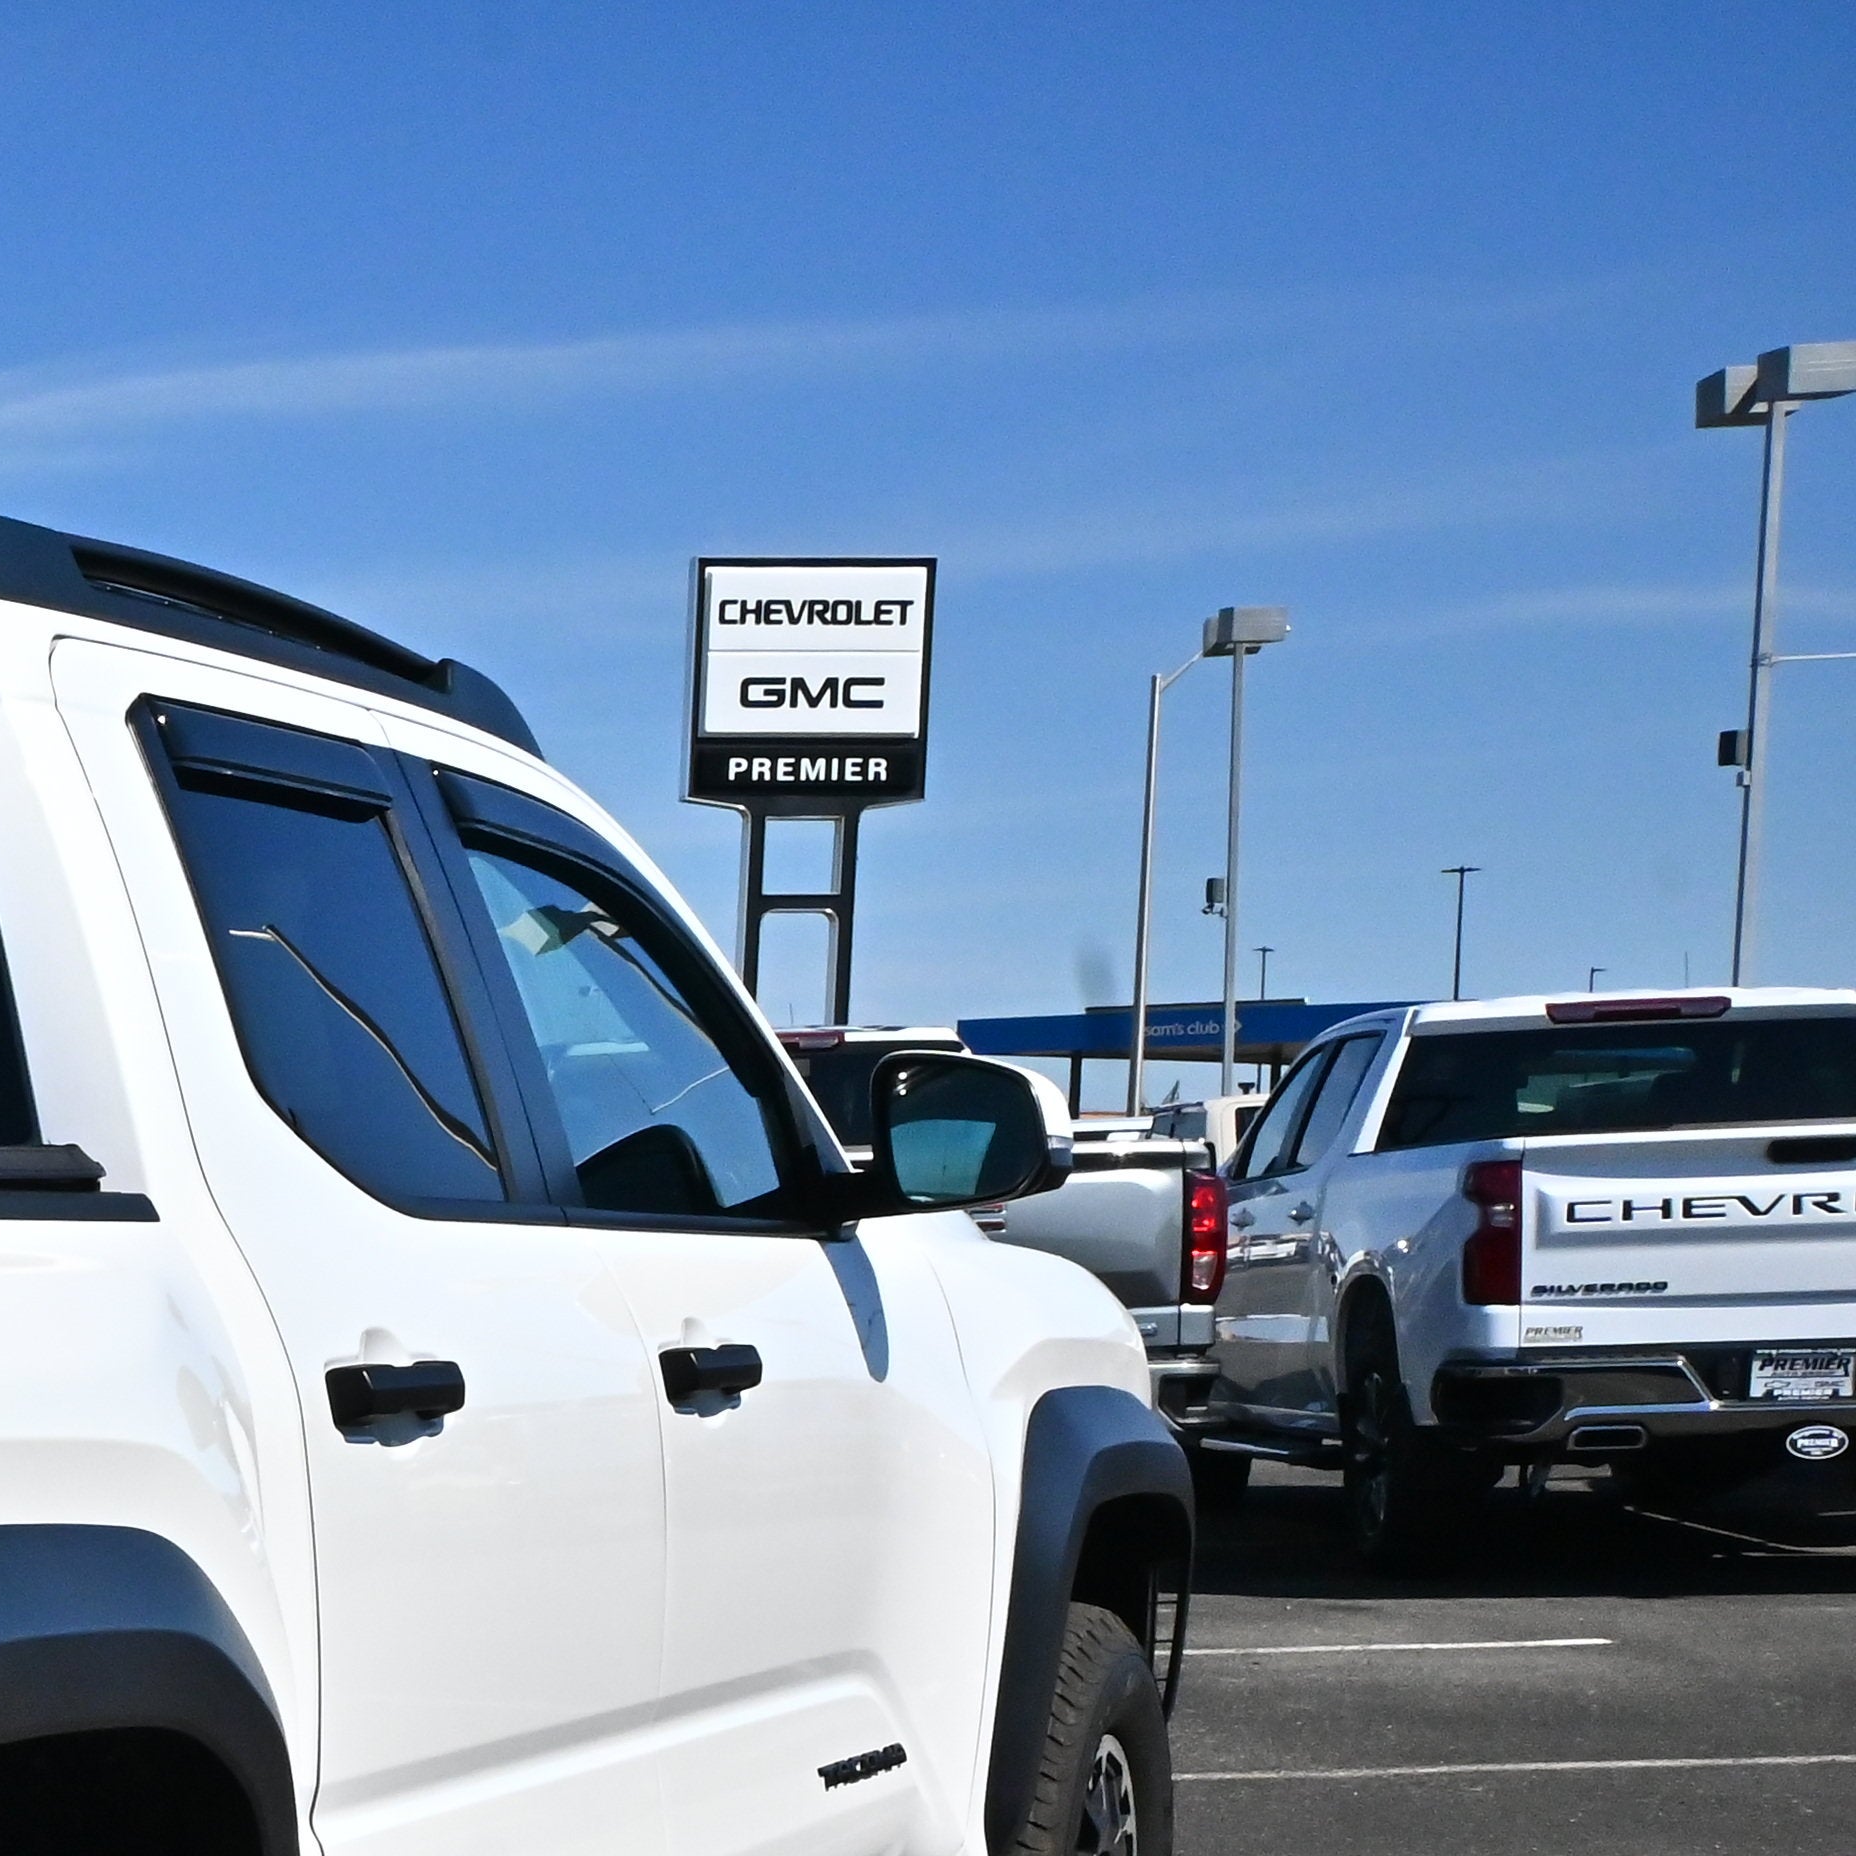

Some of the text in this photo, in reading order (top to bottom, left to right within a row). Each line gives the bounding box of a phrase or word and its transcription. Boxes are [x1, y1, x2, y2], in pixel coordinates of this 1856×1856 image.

[718, 599, 914, 626] CHEVROLET
[739, 677, 885, 708] GMC
[728, 756, 888, 782] PREMIER
[1187, 1019, 1220, 1036] club
[1566, 1192, 1856, 1223] CHEVR
[1530, 1281, 1669, 1297] SILVERADO
[1759, 1357, 1851, 1372] PREMIER
